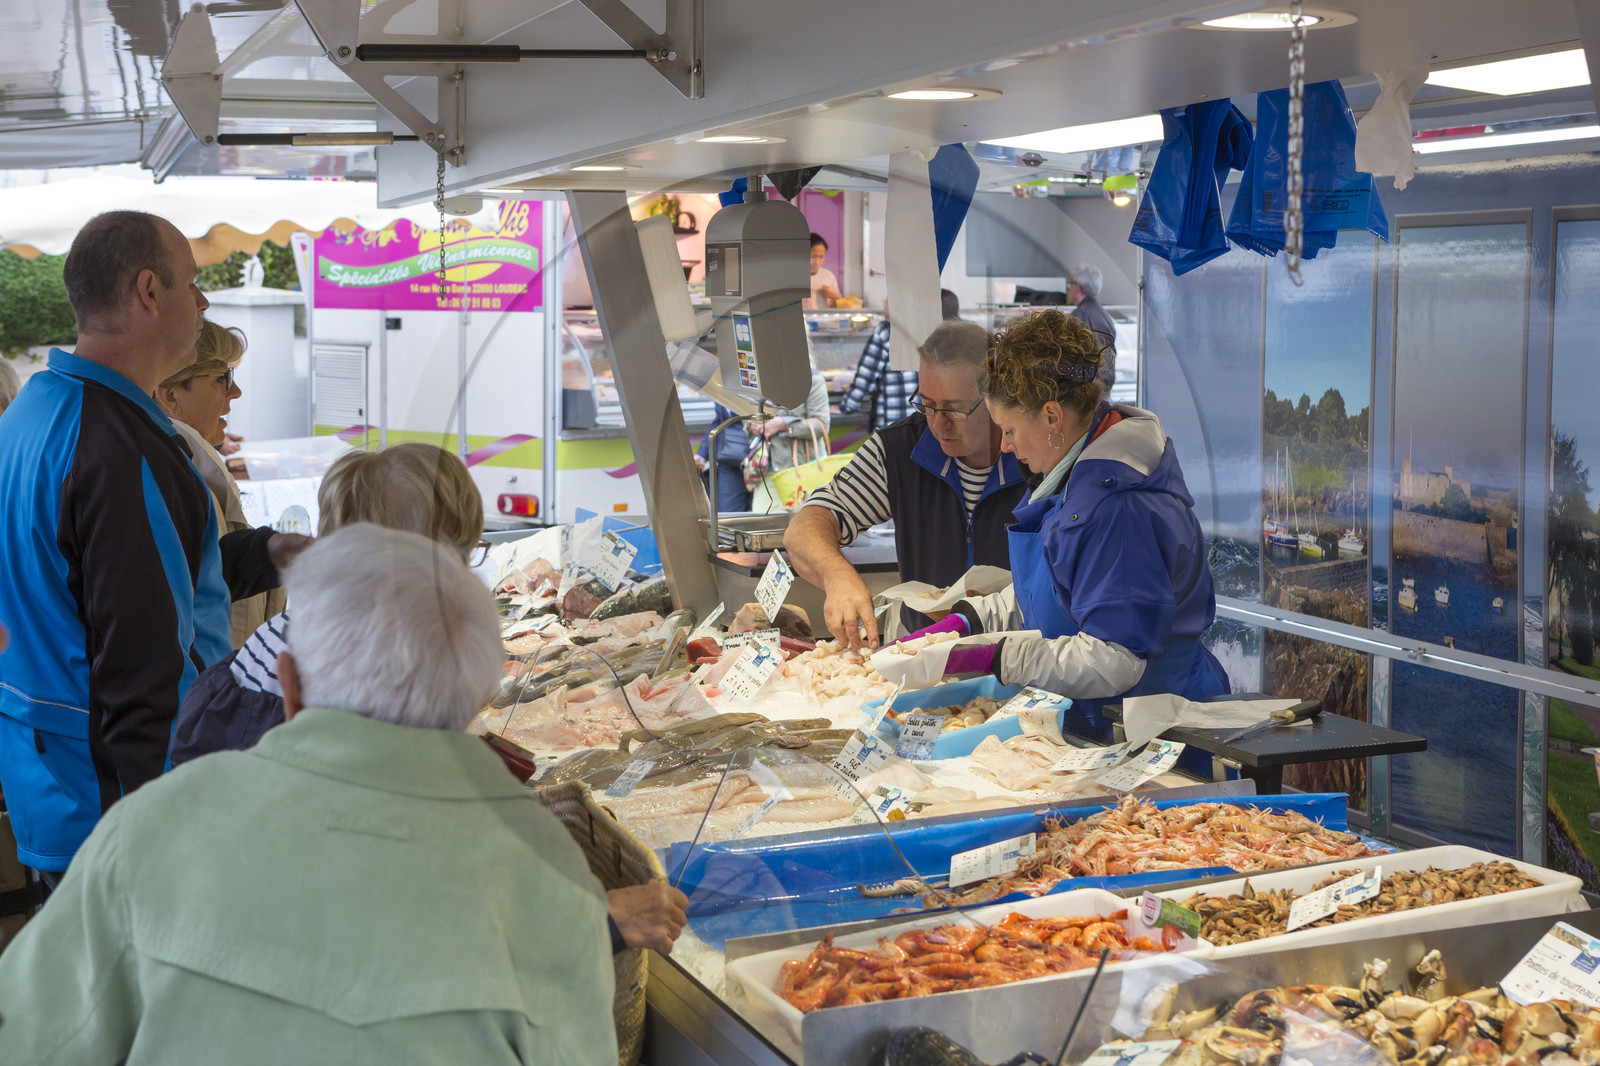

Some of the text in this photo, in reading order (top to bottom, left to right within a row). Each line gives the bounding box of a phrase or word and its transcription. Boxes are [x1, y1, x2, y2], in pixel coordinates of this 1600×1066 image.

[327, 242, 534, 288] Spécialités Vietnamiennes
[907, 717, 920, 727] Soles
[833, 761, 842, 770] DE
[1524, 957, 1549, 976] Pattes
[1548, 970, 1561, 982] de
[1560, 977, 1597, 1000] tourteau
